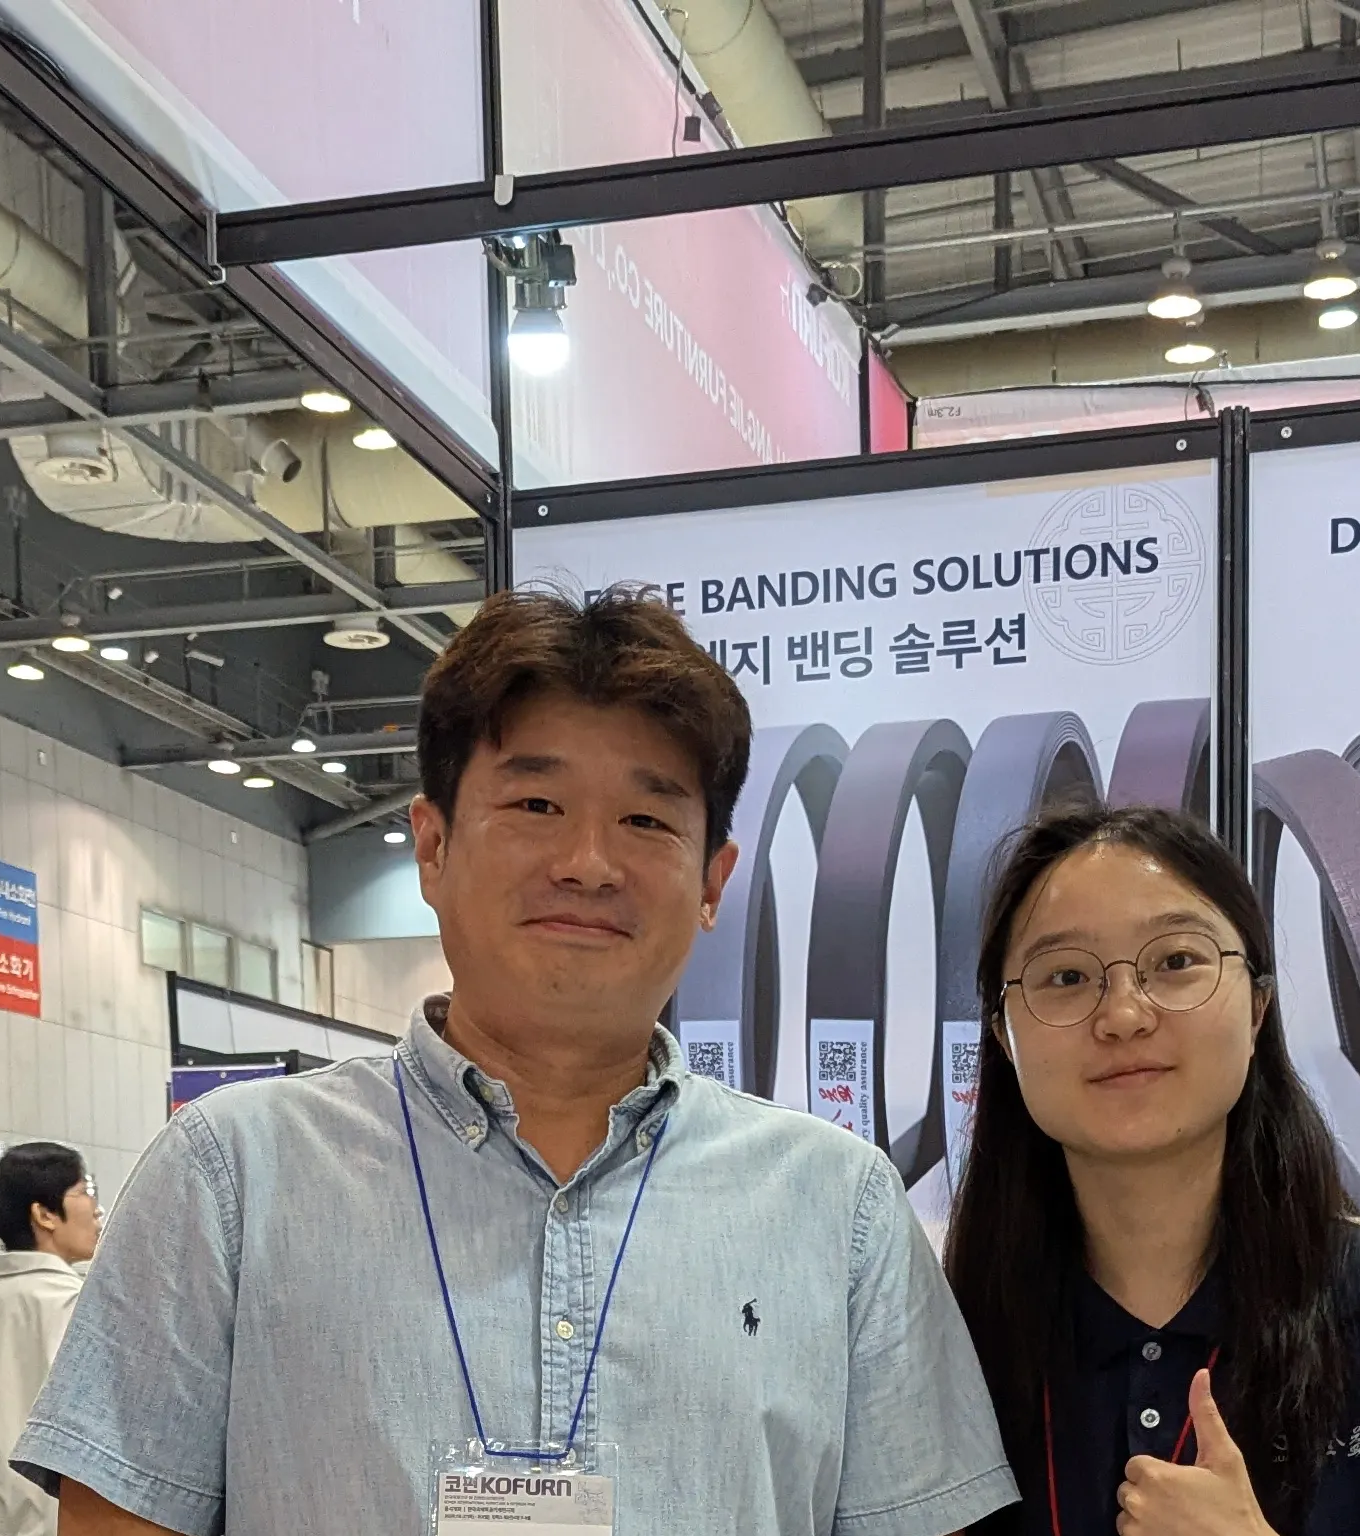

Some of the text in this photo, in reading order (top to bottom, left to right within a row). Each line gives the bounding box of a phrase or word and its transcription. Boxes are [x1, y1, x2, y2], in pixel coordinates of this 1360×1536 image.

[700, 562, 897, 615] BANDING
[913, 537, 1160, 595] SOLUTIONS
[786, 625, 873, 683] 밴딩
[888, 612, 1029, 675] 솔루션
[859, 1041, 869, 1091] assurance
[860, 1092, 871, 1125] quality
